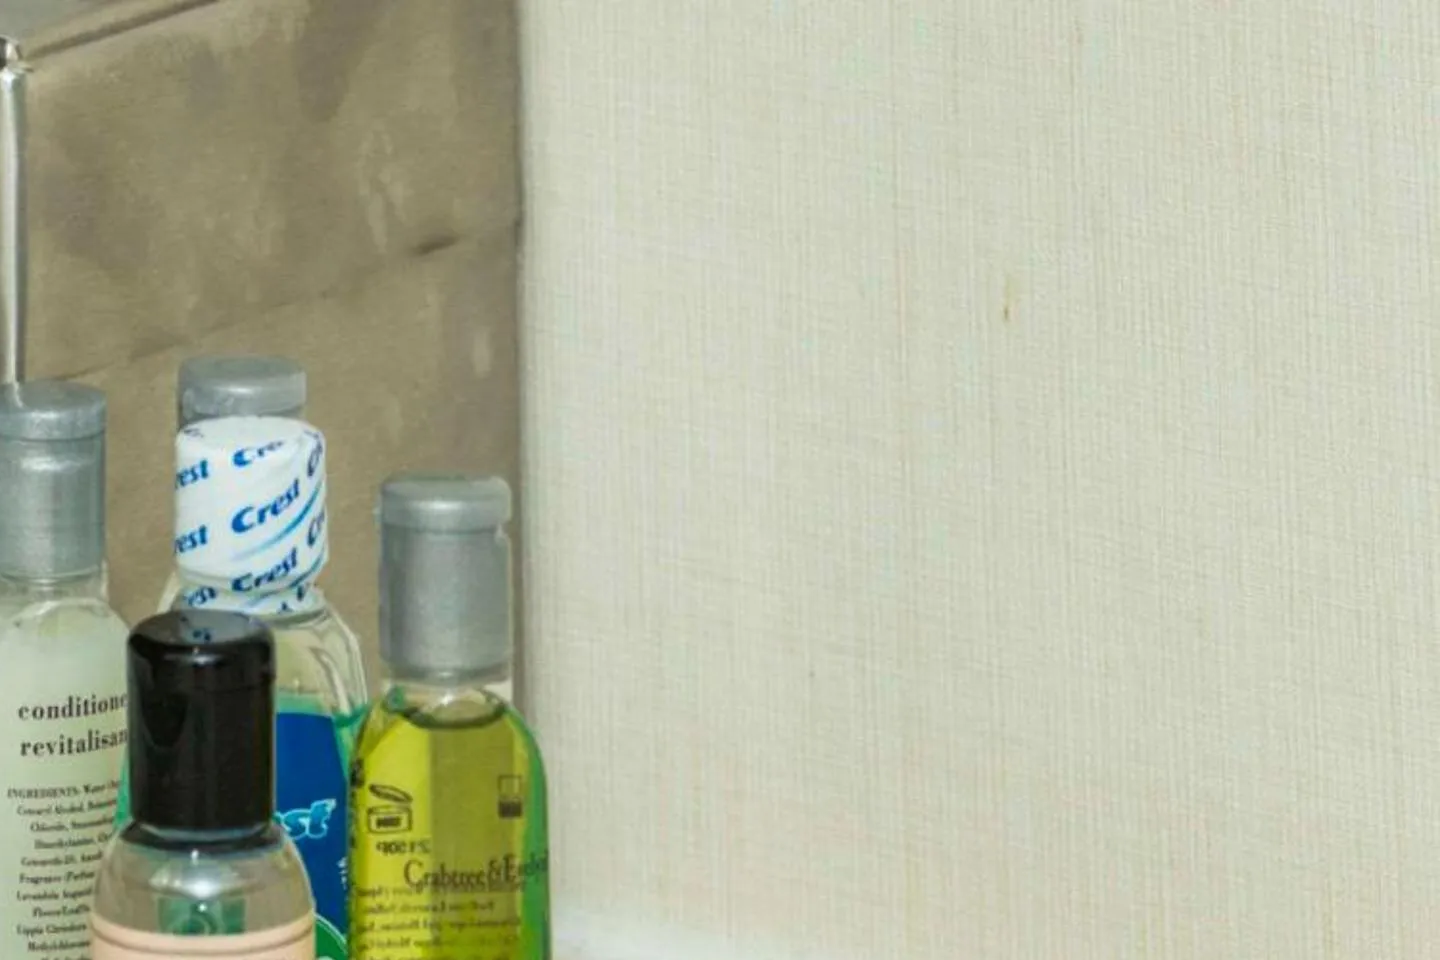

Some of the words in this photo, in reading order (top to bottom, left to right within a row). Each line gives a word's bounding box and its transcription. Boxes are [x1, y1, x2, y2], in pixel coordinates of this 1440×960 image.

[231, 478, 300, 533] Crest
[232, 547, 298, 592] Crest
[20, 729, 128, 756] revitalisan
